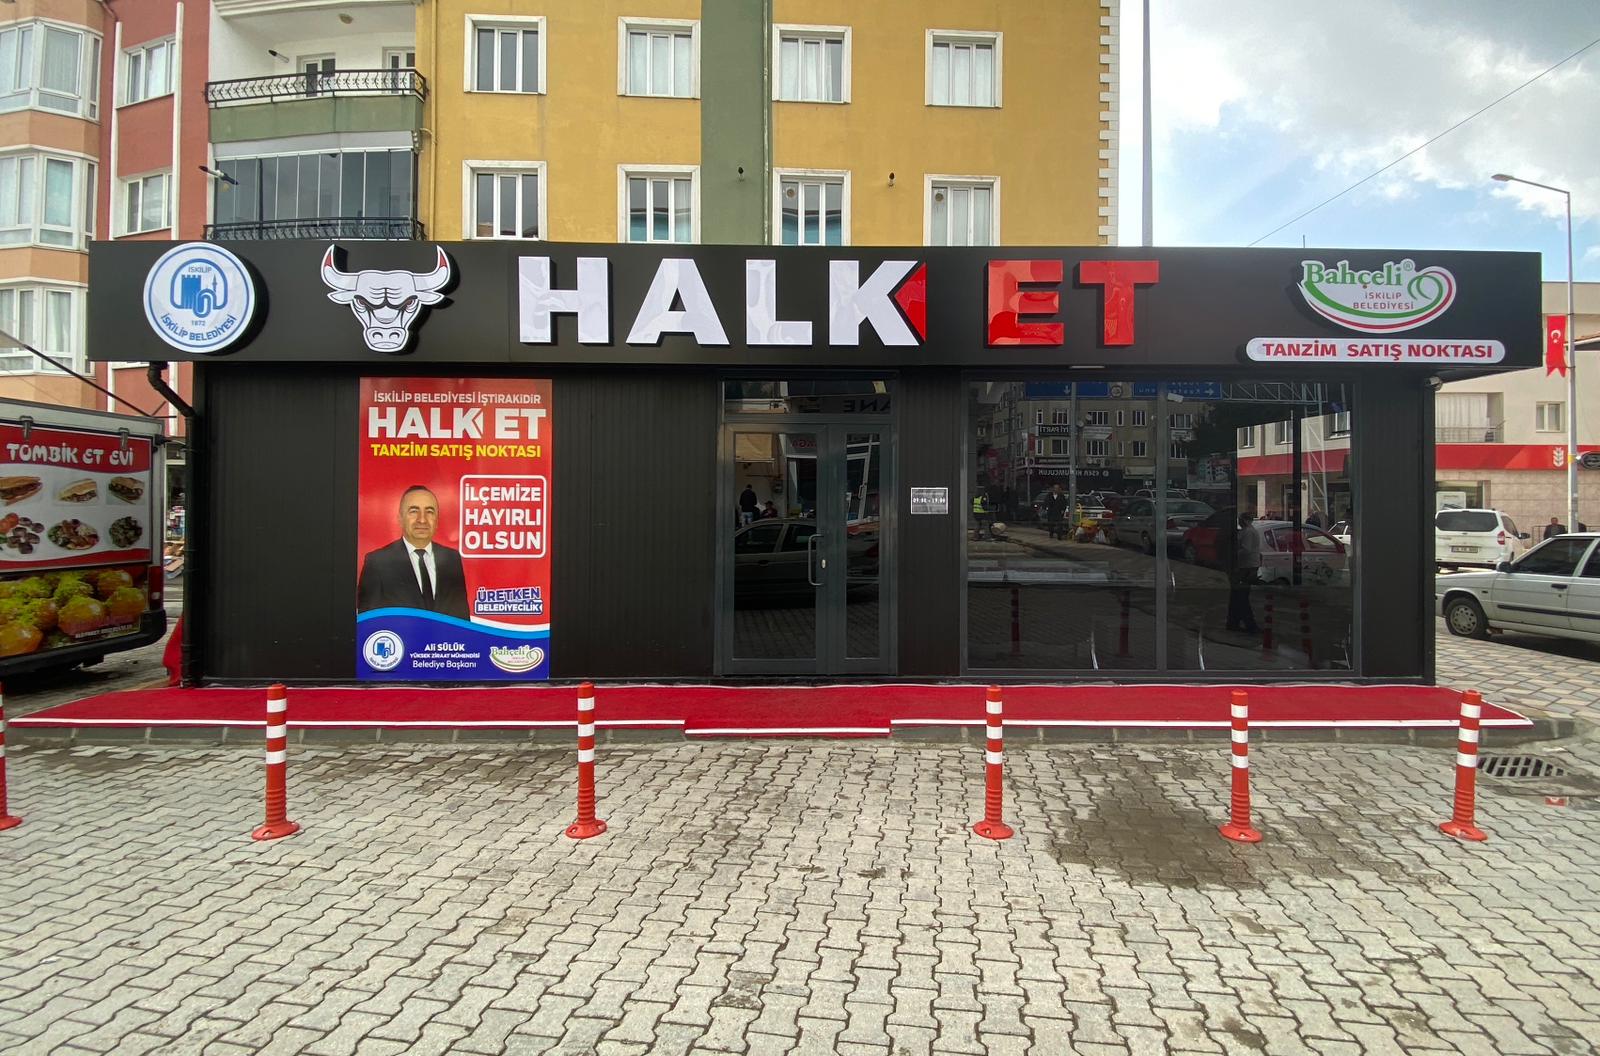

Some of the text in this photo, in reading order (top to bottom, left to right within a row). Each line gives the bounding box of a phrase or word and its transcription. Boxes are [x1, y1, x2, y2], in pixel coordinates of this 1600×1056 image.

[1305, 262, 1403, 289] Bahçeli
[518, 256, 1160, 346] HALK ET
[1365, 291, 1402, 300] İSKİLİP
[1353, 301, 1414, 310] BELEDİYESİ
[161, 313, 237, 341] İSKİLİP BELEDİYESİ
[1262, 340, 1492, 360] TANZİM SATIŞ NOKTASI
[374, 390, 541, 406] İSKİLİP BELEDİYESİ İŞTİRAKİDİR
[368, 406, 546, 439] HALK ET
[6, 442, 134, 466] TOMBİK ET EVİ
[371, 441, 541, 460] TANZİM SATIŞ NOKTASI
[465, 483, 541, 505] İLÇEMİZE
[465, 508, 541, 526] HAYIRLI
[465, 531, 541, 550] OLSUN
[478, 587, 540, 602] ÜRETKEN
[477, 601, 539, 612] BELEDİYECİLİK
[424, 642, 465, 651] Ali SÜLÜK
[413, 660, 476, 669] Belediye Başkanı
